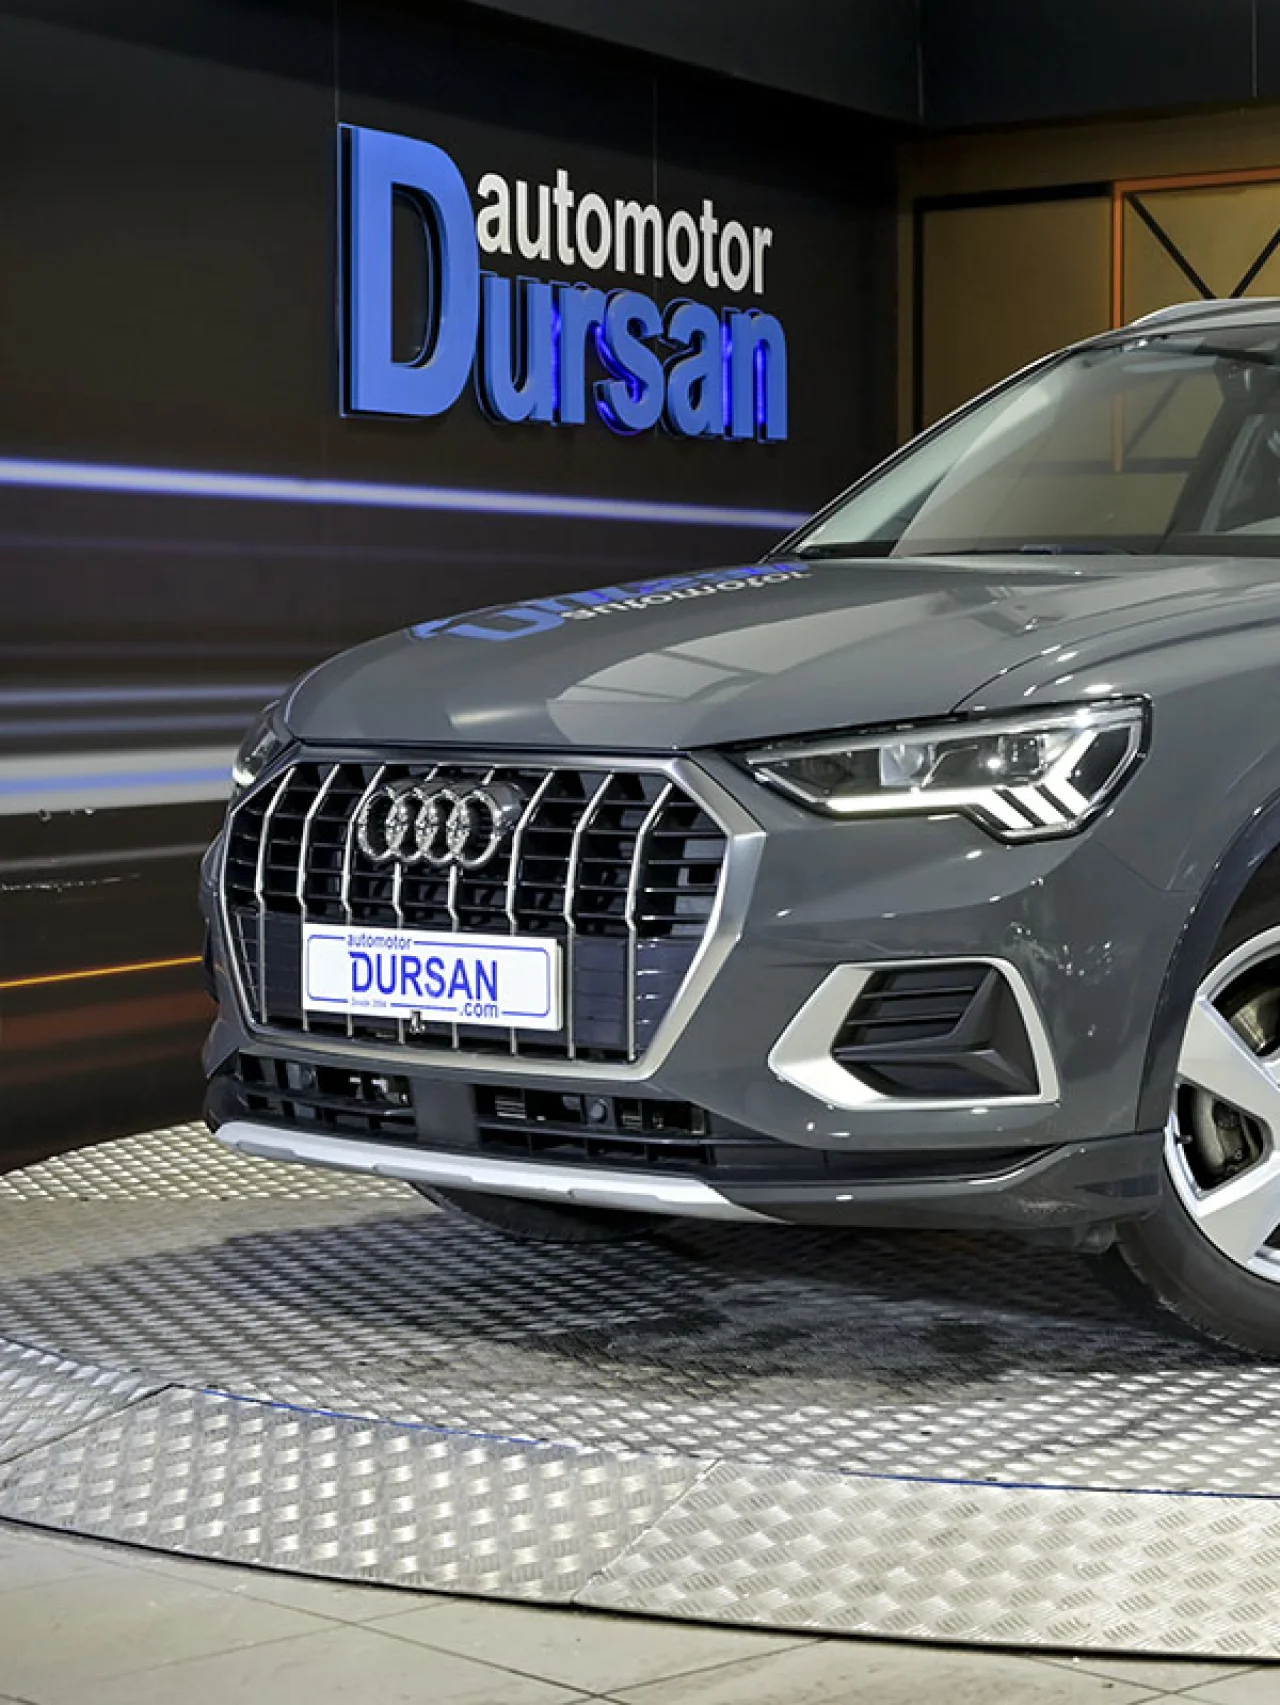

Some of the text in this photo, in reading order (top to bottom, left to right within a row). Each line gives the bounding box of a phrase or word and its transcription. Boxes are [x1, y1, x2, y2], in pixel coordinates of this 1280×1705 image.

[475, 168, 773, 294] automotor
[338, 122, 788, 443] Dursan
[347, 934, 412, 950] automotor
[348, 951, 498, 1001] DURSAN
[459, 1003, 499, 1019] .com
